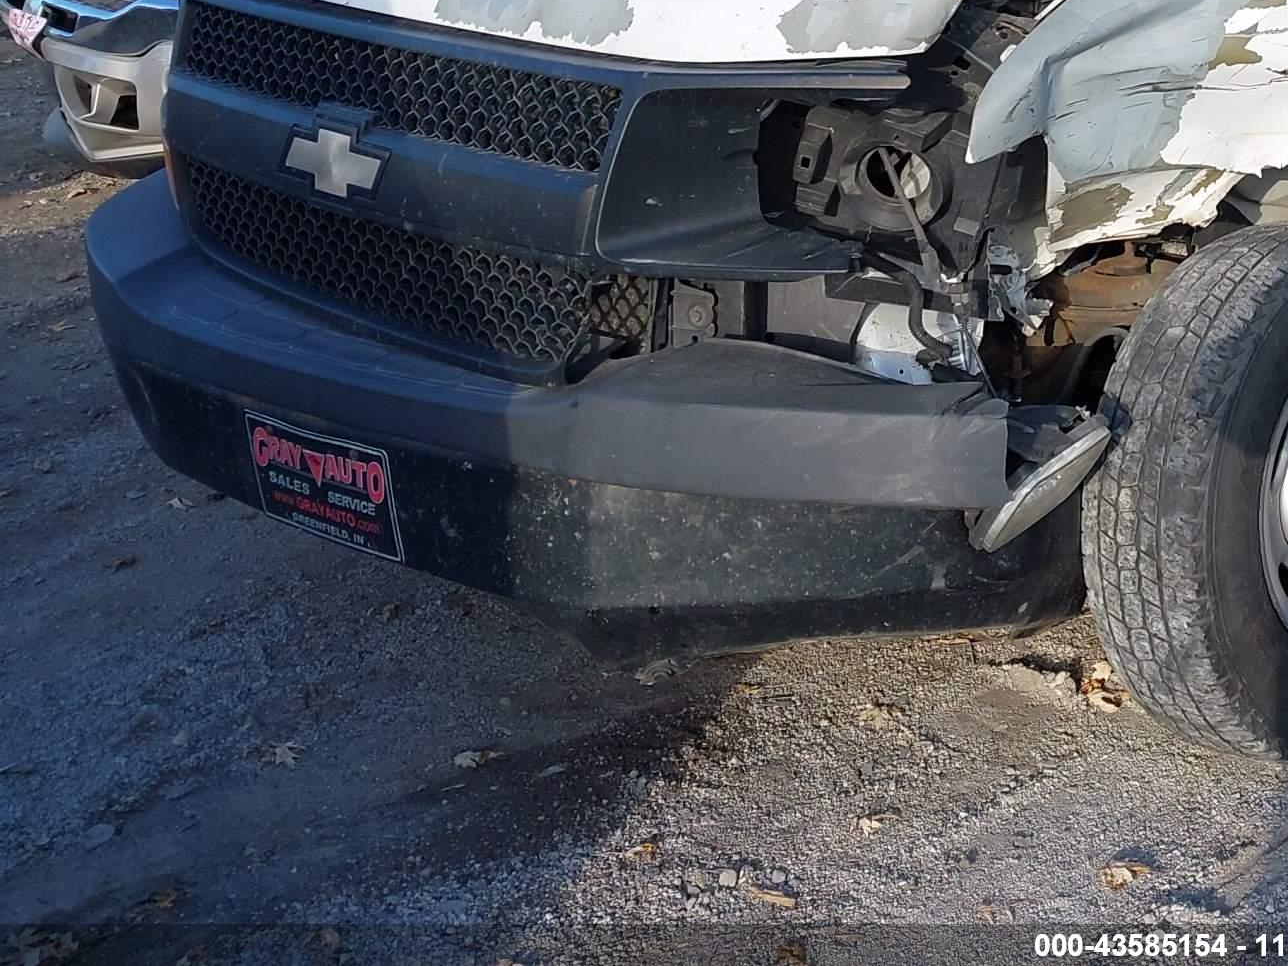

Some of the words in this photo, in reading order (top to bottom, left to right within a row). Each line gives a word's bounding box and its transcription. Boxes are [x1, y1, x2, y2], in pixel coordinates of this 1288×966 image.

[252, 426, 302, 470] GRAY
[324, 453, 385, 505] AUTO
[268, 470, 311, 495] SALES
[327, 490, 376, 516] SERVICE
